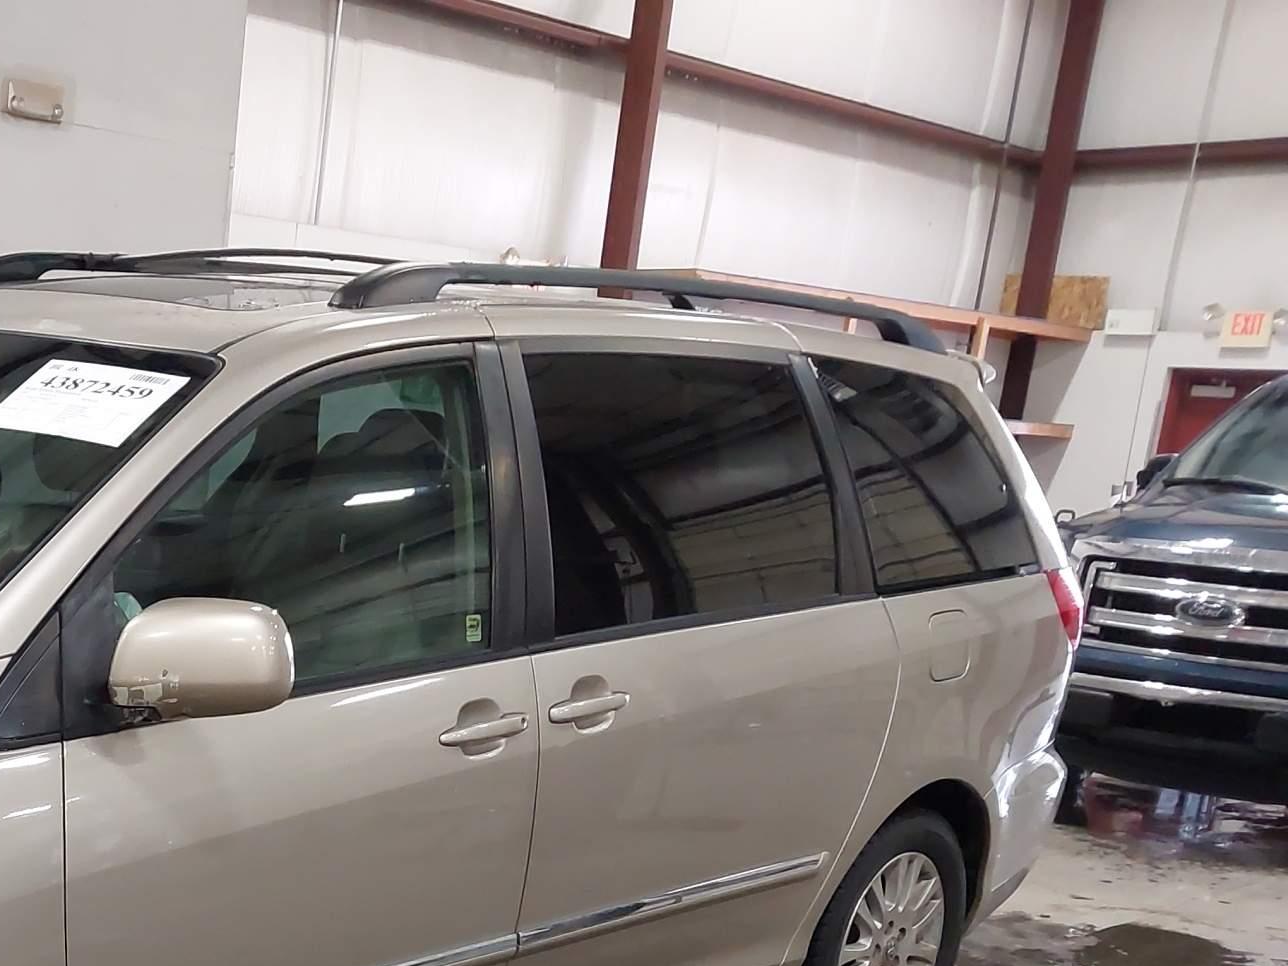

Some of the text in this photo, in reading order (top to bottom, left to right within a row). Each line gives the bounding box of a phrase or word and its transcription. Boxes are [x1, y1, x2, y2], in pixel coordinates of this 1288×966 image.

[1231, 312, 1266, 336] EXIT
[40, 374, 154, 400] 43872459
[1188, 601, 1224, 617] Ford
